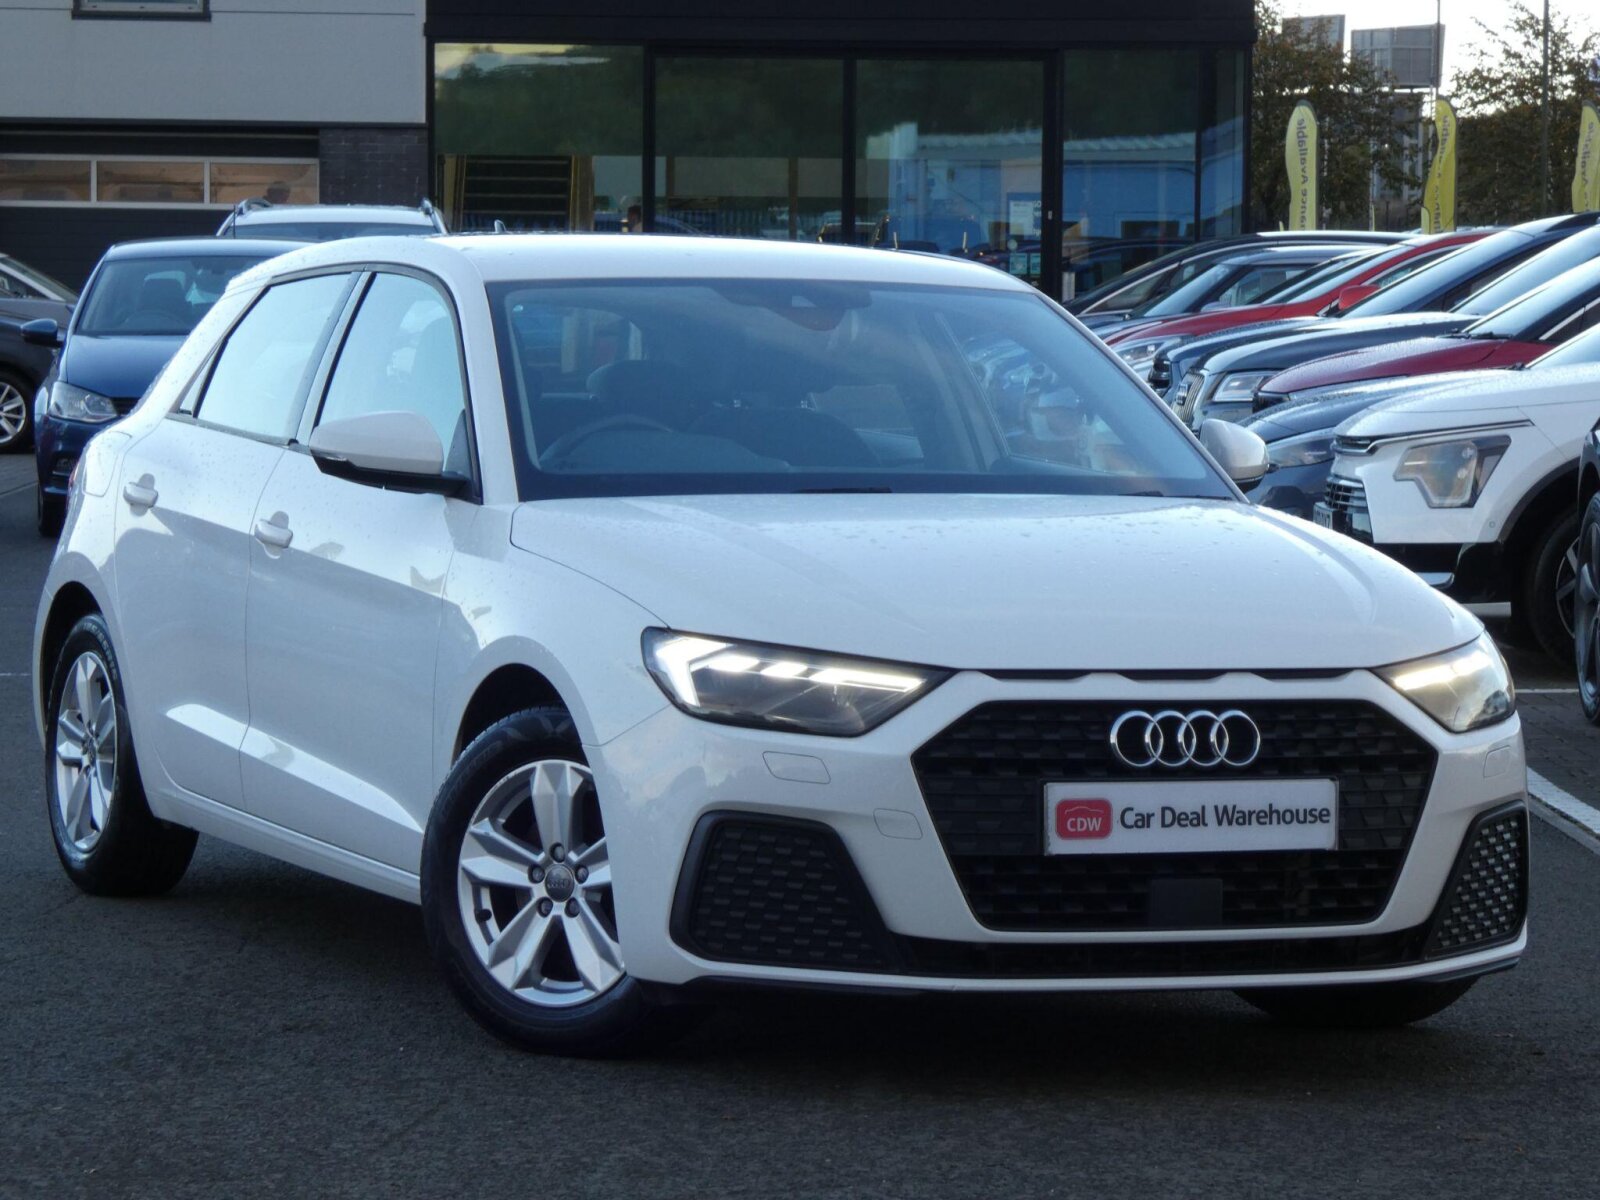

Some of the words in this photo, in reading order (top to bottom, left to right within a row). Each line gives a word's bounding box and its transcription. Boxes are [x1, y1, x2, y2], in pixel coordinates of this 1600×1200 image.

[1066, 817, 1102, 832] CDW
[1119, 807, 1154, 829] Car
[1160, 805, 1208, 828] Deal
[1214, 803, 1330, 827] Warehouse
